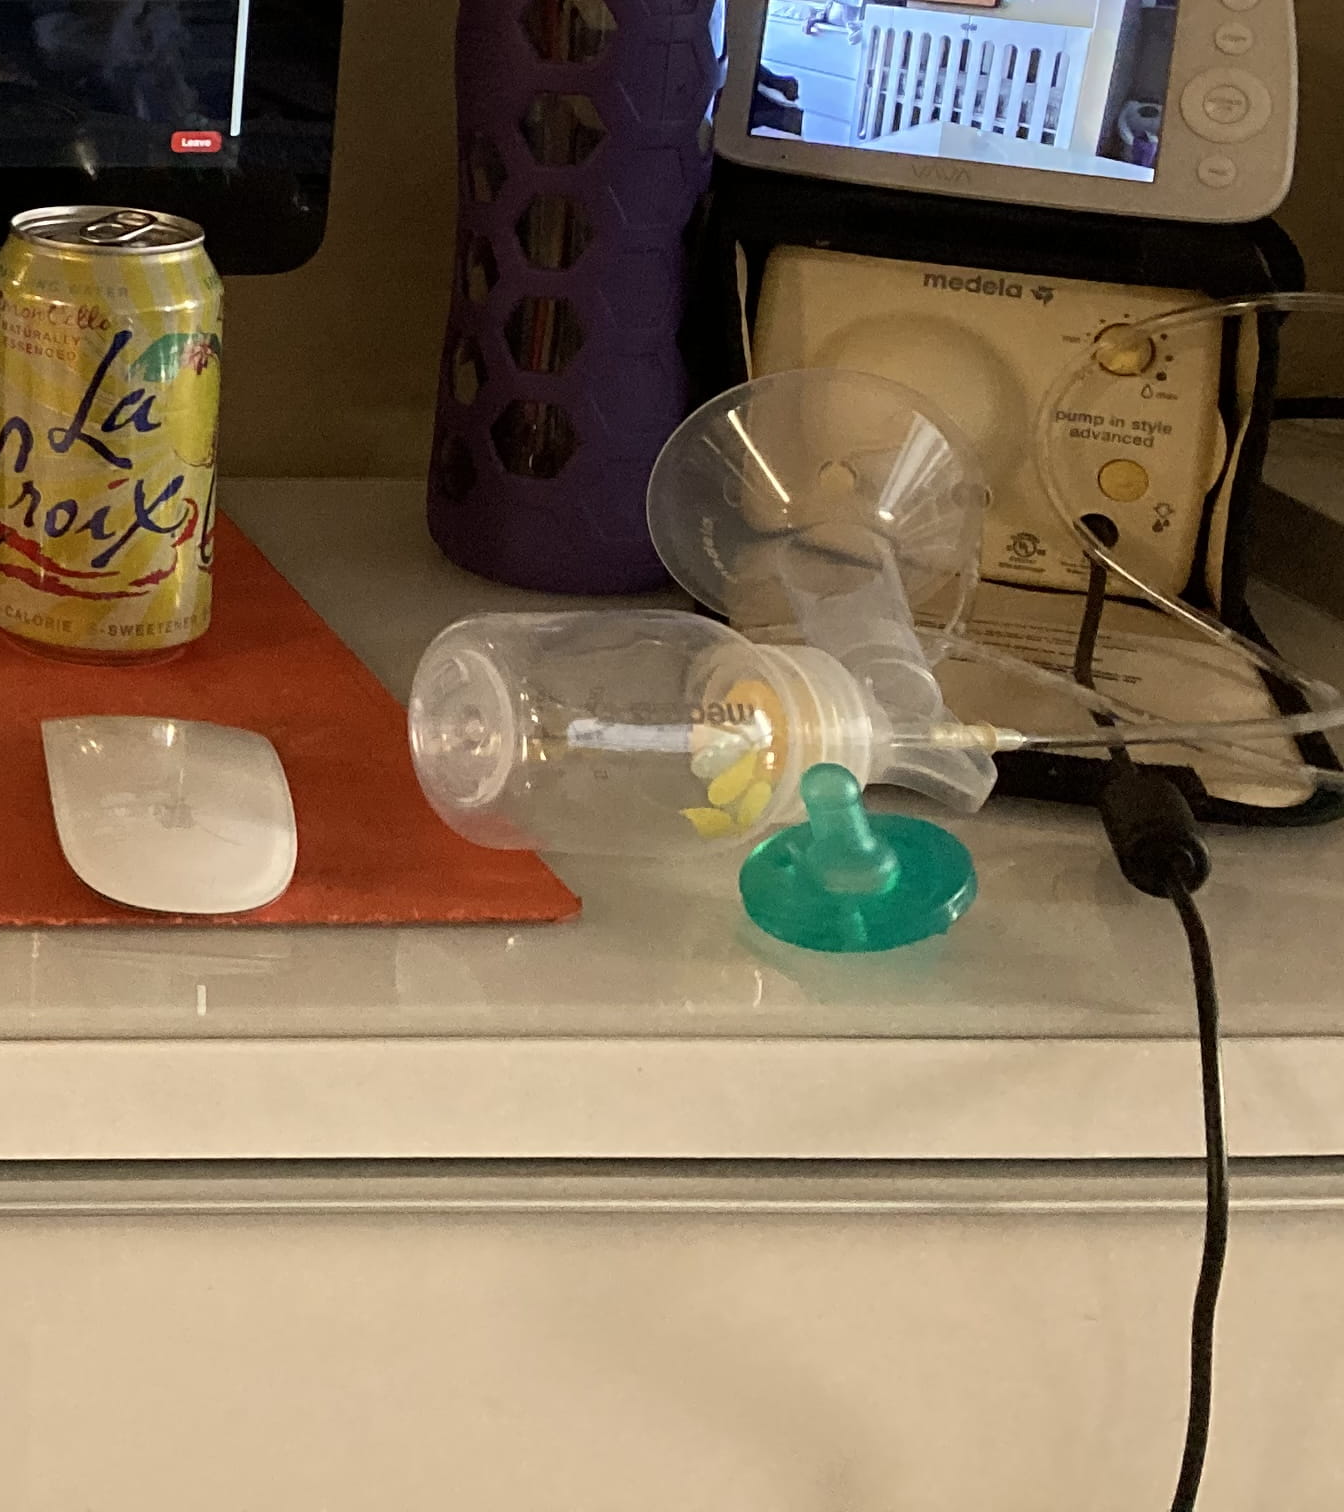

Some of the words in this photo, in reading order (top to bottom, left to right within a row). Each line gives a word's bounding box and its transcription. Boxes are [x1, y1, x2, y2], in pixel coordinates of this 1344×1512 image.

[924, 271, 1023, 298] medela
[48, 330, 162, 470] La
[1055, 409, 1105, 428] pump
[1132, 420, 1173, 436] style
[1069, 428, 1155, 449] advanced
